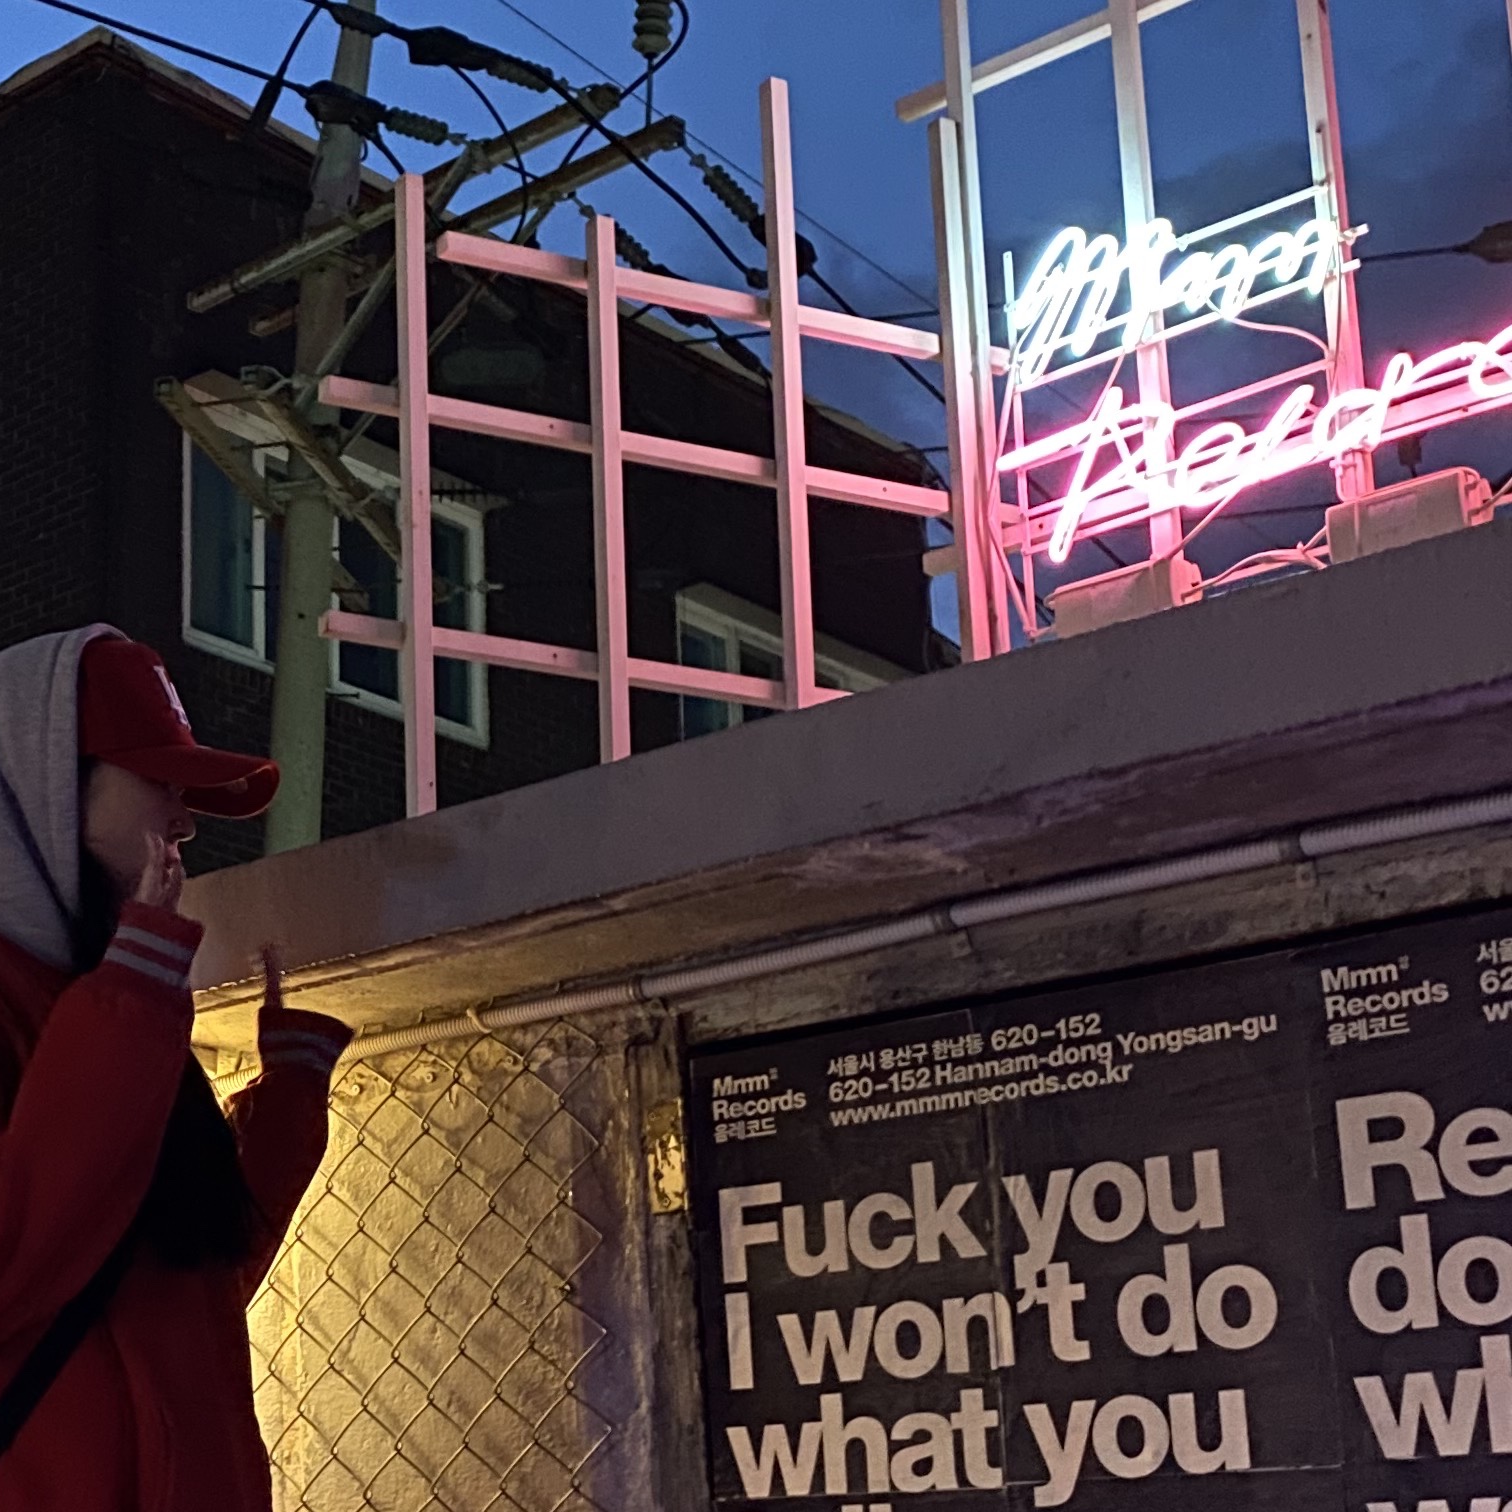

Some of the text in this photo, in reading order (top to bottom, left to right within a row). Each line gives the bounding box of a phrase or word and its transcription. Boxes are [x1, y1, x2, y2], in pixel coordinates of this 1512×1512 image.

[826, 1012, 1102, 1078] 서울시 용산구 한남동 620-152
[1324, 980, 1450, 1020] Records
[829, 1011, 1278, 1103] 620-152 Hannam-dong Yongsan-gu
[829, 1060, 1134, 1128] www.mmmrecords.co.kr
[712, 1088, 807, 1121] Records
[718, 1148, 1226, 1290] Fuck you
[725, 1243, 1278, 1391] I won't do
[1347, 1213, 1512, 1334] do
[726, 1387, 1252, 1508] what you
